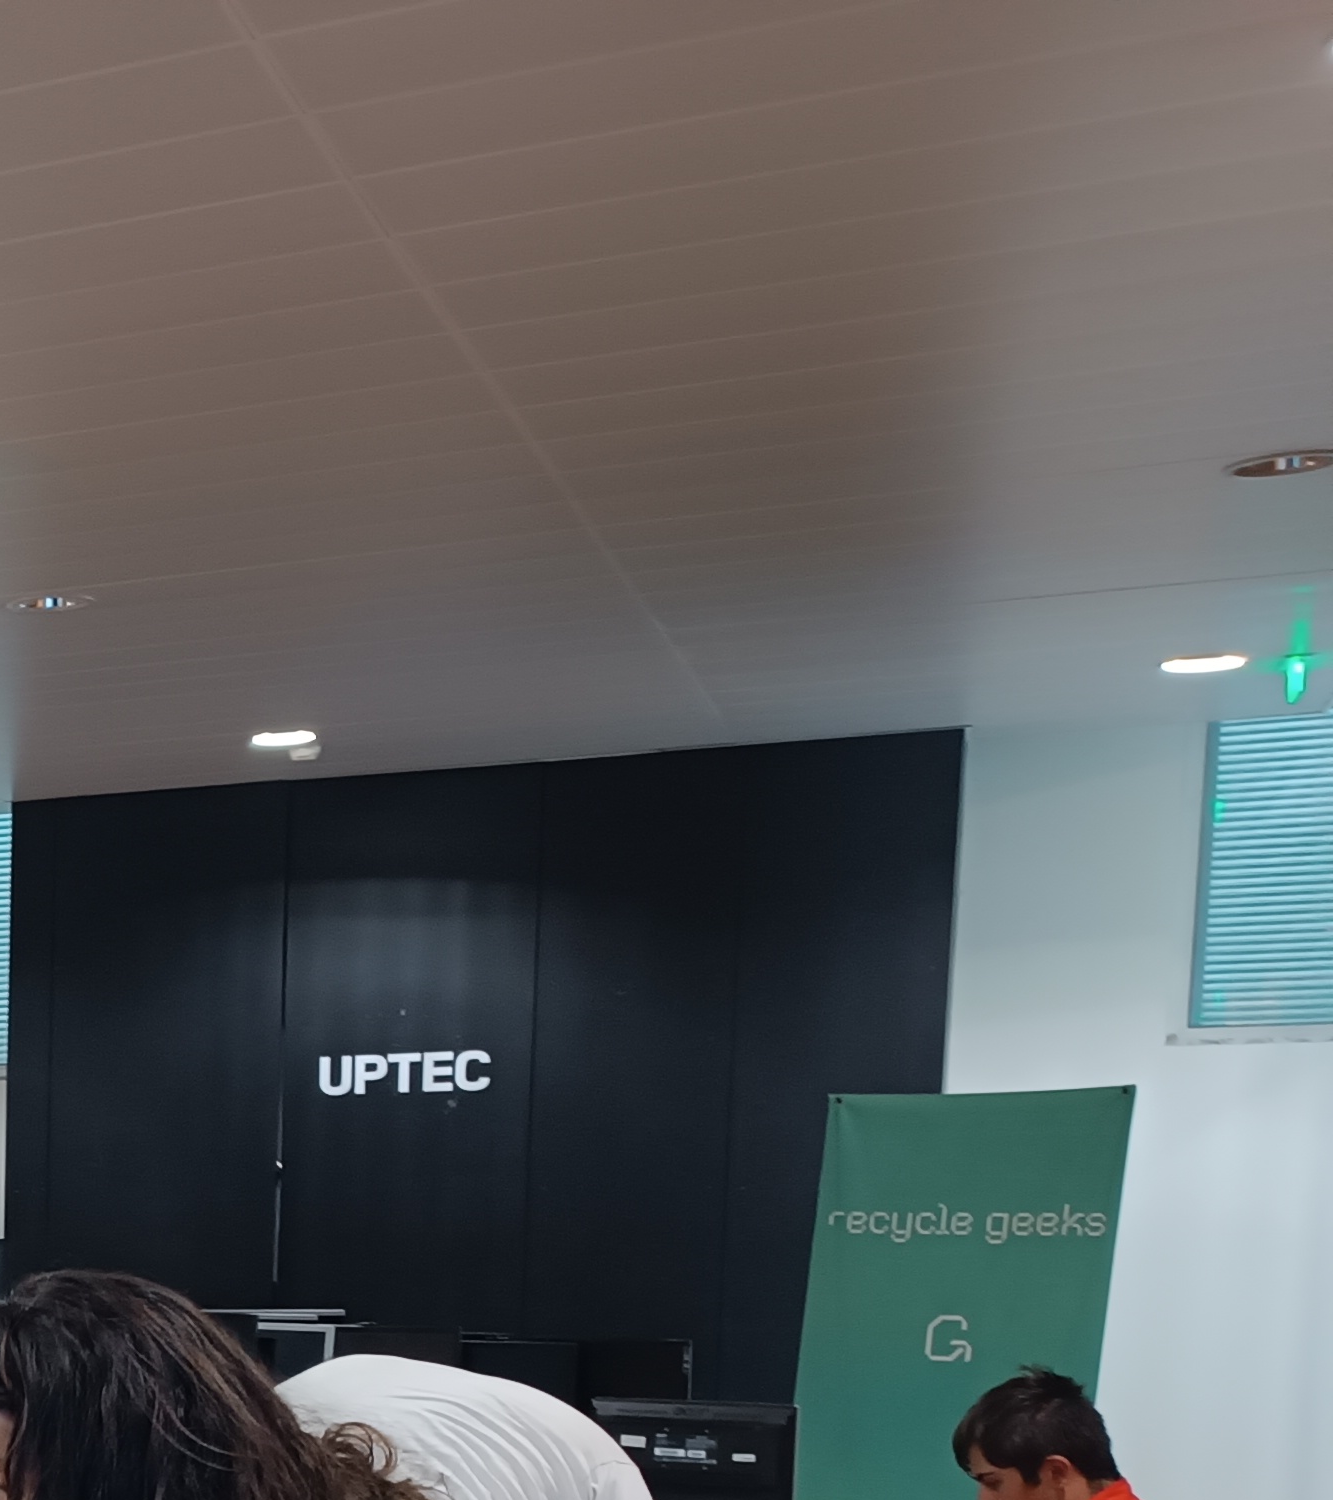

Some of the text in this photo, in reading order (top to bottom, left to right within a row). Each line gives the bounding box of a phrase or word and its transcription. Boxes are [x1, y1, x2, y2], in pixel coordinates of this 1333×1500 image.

[318, 1049, 492, 1096] UPTEC
[828, 1203, 1107, 1244] recycle geeks
